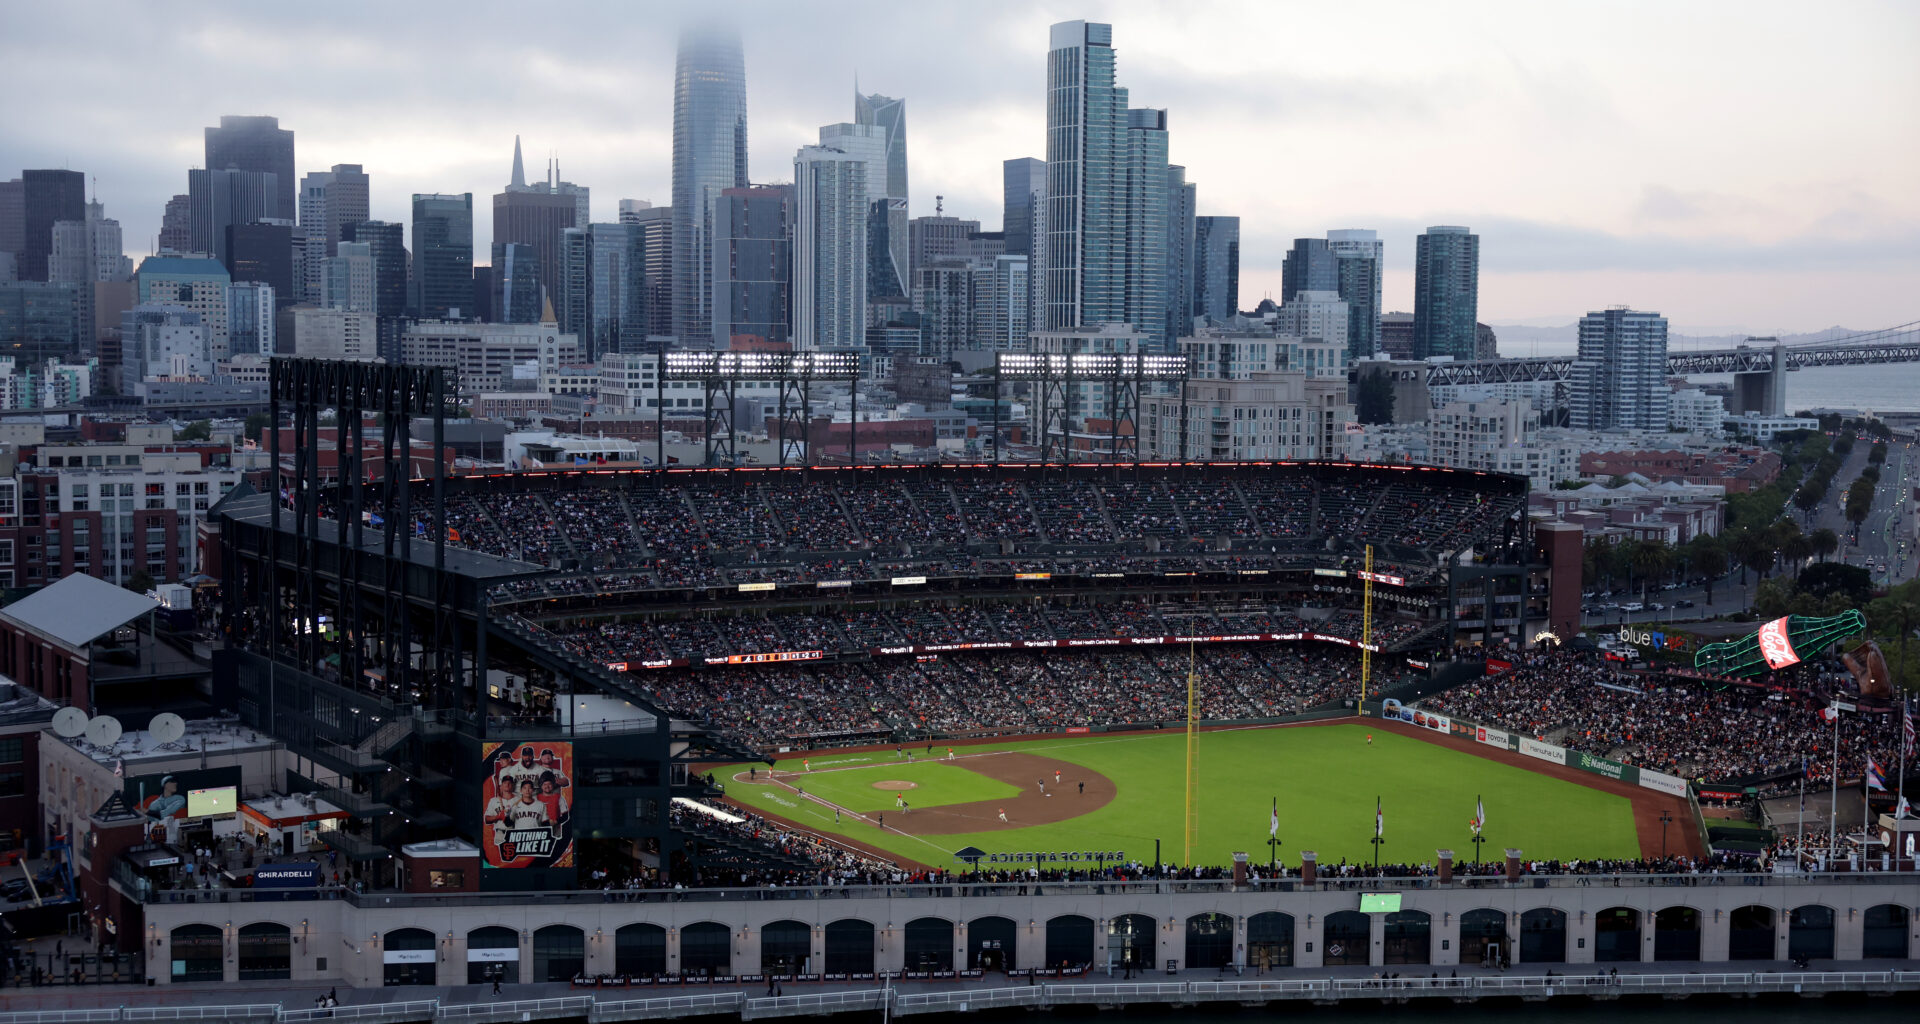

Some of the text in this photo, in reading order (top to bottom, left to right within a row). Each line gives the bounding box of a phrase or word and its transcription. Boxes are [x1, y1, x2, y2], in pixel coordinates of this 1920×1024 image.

[1620, 626, 1650, 646] blue
[1488, 734, 1507, 743] TOYOTA
[1529, 745, 1563, 759] Hanwha Life
[1590, 758, 1622, 774] National
[515, 811, 541, 820] GIANTS
[509, 831, 549, 843] NOTHING
[516, 839, 551, 853] LIKE IT
[258, 871, 313, 879] GHIRARDELLI
